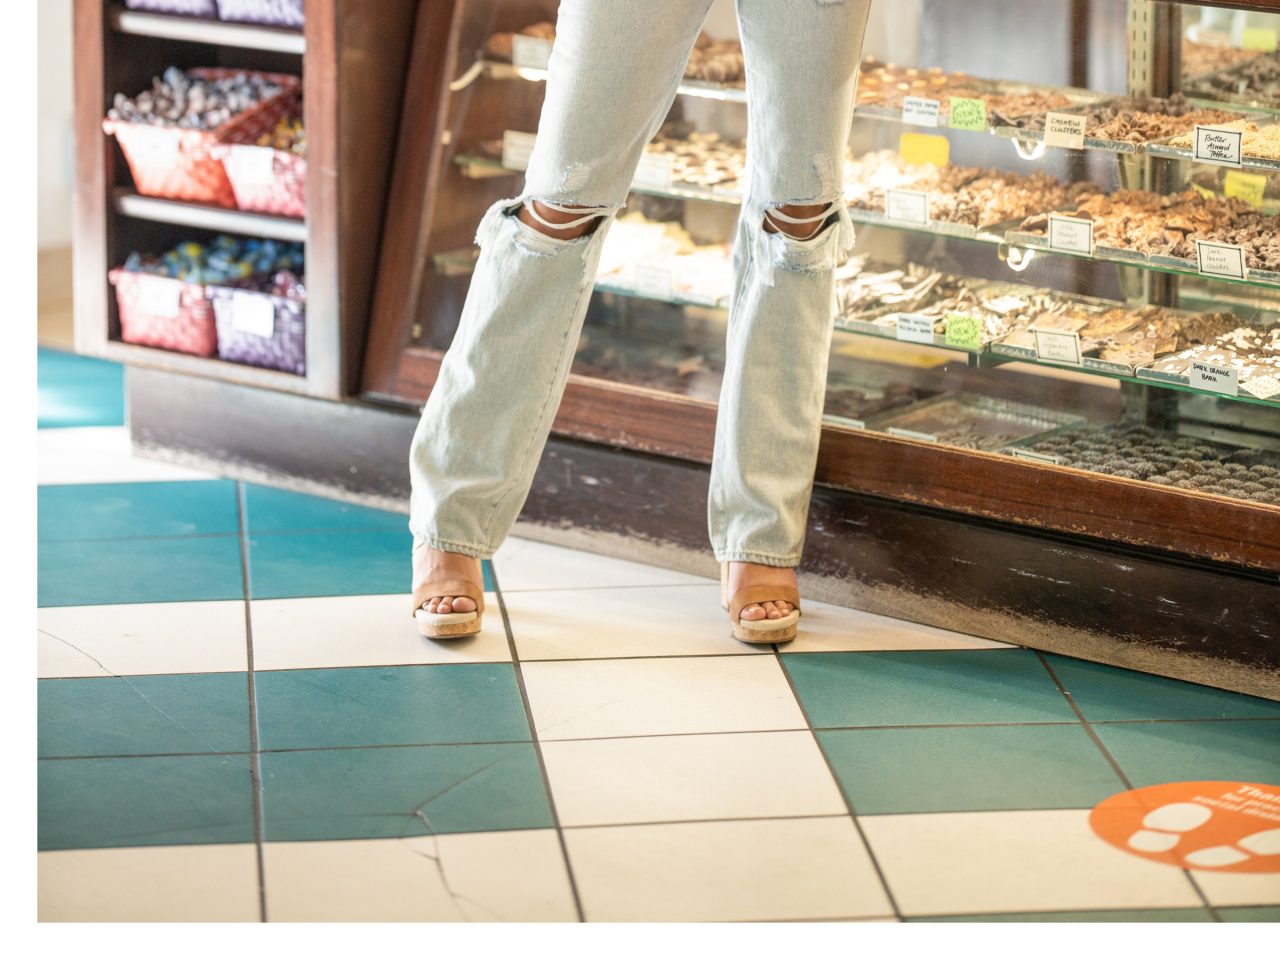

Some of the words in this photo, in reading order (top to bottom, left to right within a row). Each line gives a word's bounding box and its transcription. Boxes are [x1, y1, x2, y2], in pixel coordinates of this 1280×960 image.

[1050, 117, 1081, 127] CASHEW
[1050, 126, 1082, 136] CLUSTERS
[1193, 363, 1208, 372] DARK
[1209, 367, 1231, 377] ORANGE
[1201, 373, 1219, 382] BARK
